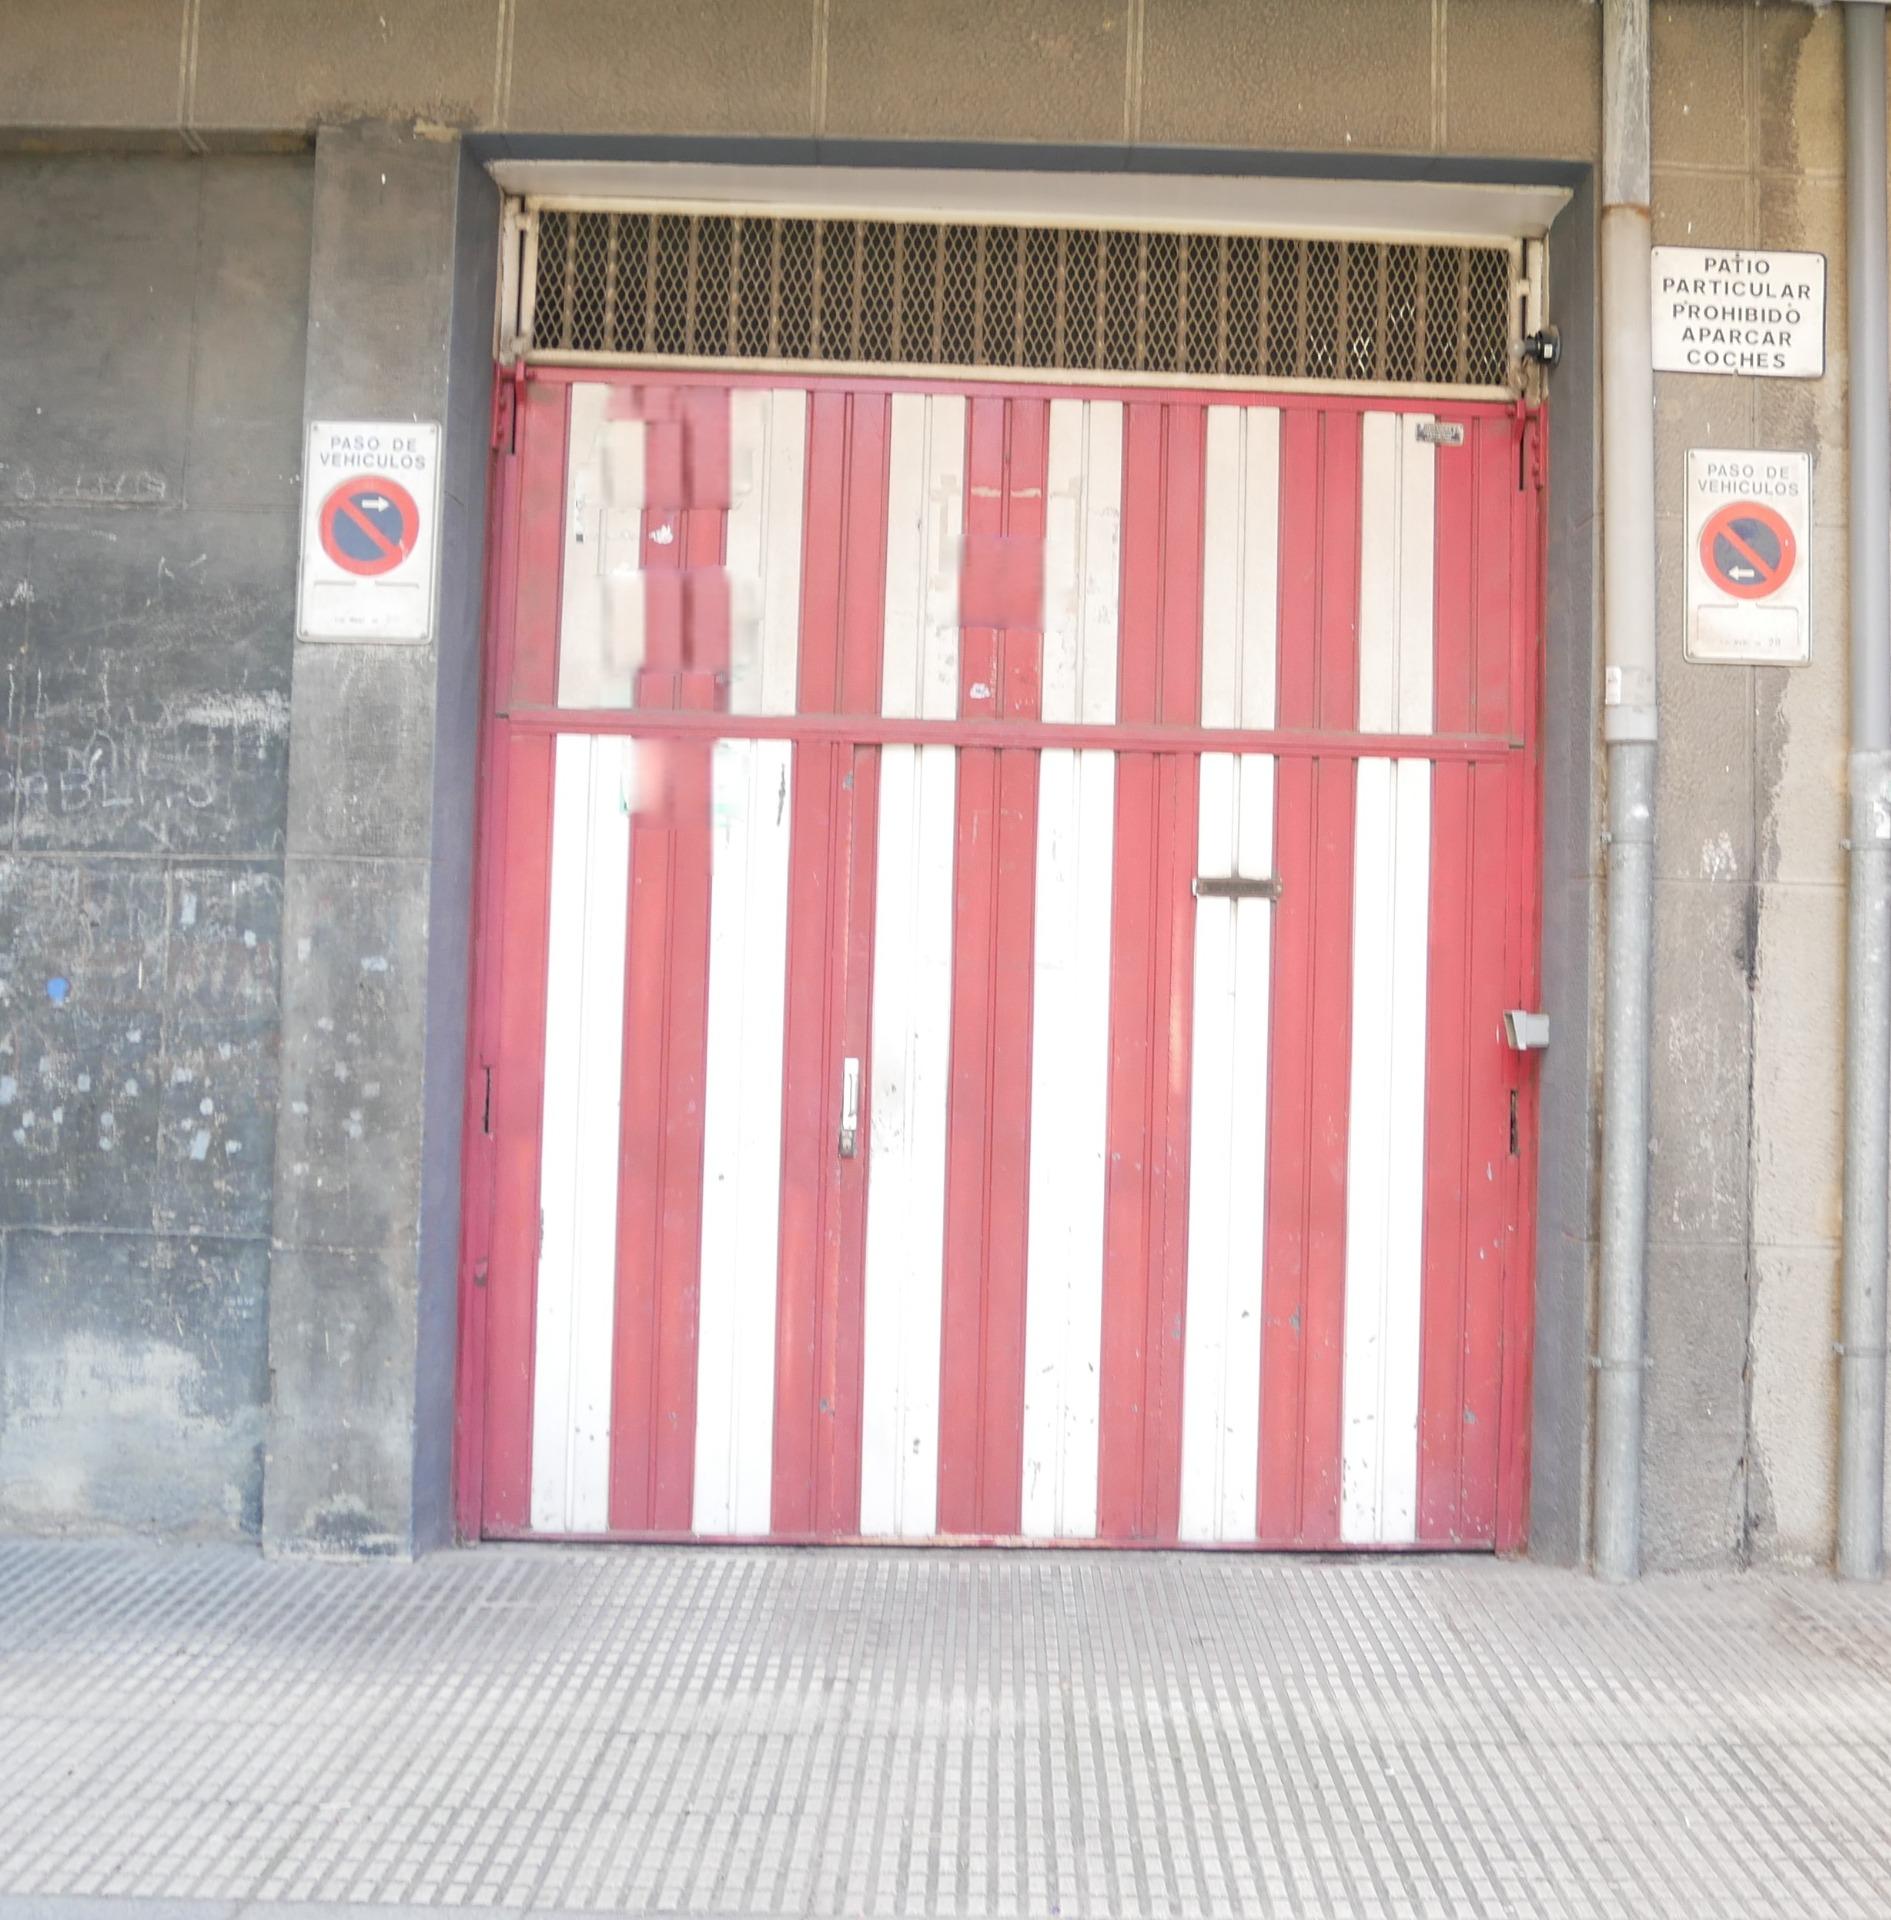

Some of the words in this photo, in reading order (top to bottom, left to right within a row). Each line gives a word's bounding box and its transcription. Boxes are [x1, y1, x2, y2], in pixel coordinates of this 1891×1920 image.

[1704, 257, 1770, 275] PATIO
[1662, 278, 1811, 299] PARTICULAR
[1672, 303, 1801, 325] PROHIBIDO
[1682, 327, 1792, 346] APARCAR
[1687, 349, 1786, 369] COCHES
[330, 435, 380, 451] PASO
[392, 437, 417, 452] DE
[319, 452, 426, 470] VEHICULOS
[1707, 463, 1754, 478] PASO
[1766, 466, 1790, 479] DE
[1697, 479, 1799, 497] VEHICULOS
